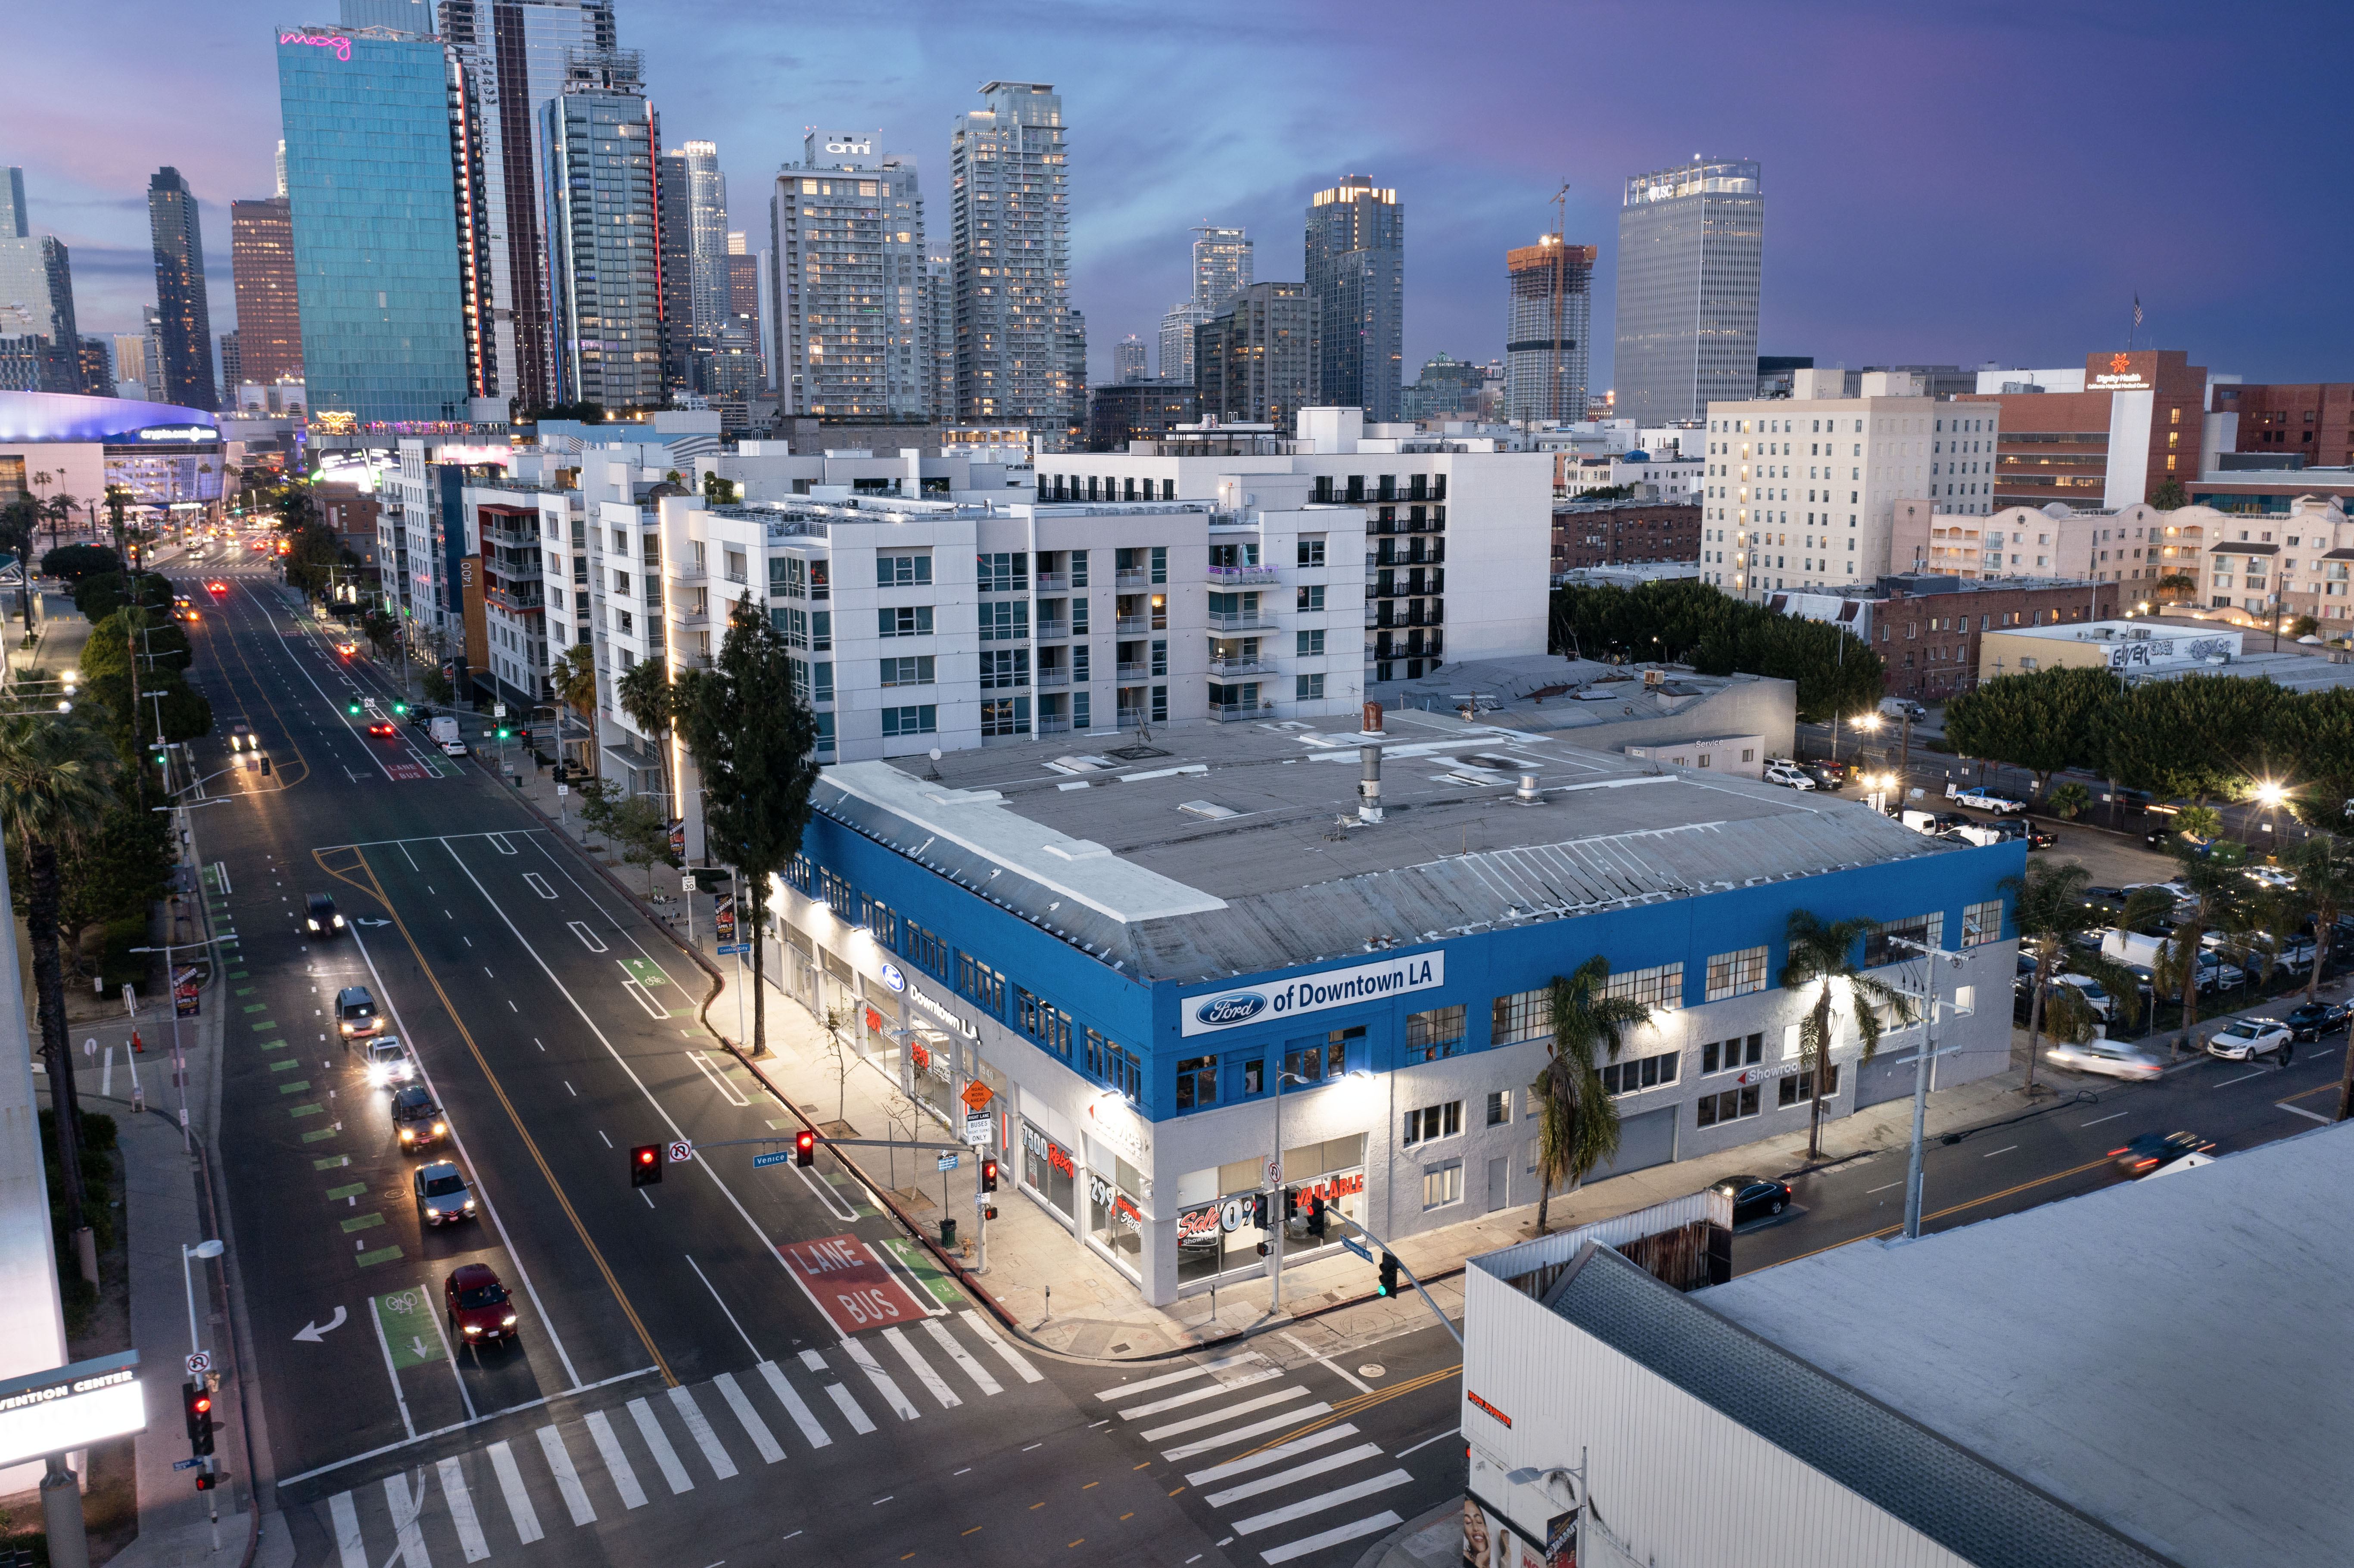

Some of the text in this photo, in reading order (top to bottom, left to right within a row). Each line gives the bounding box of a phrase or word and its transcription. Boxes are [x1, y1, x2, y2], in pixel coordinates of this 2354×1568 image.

[280, 34, 352, 61] moxy
[825, 141, 871, 155] onni
[1657, 184, 1672, 199] USC
[2096, 373, 2141, 384] Dignity Health
[461, 563, 473, 588] 1400
[1695, 739, 1723, 748] Service
[716, 898, 733, 914] SUMMIT
[1210, 961, 1432, 1021] Ford of Downtown LA
[866, 1007, 881, 1034] 389
[911, 984, 960, 1031] Downtown
[962, 1019, 981, 1045] LA
[979, 1064, 993, 1080] 1540
[1749, 1063, 1800, 1082] Showroo
[757, 1155, 785, 1164] Venice
[1296, 1174, 1363, 1208] VAILABLE
[1178, 1207, 1220, 1239] Sale
[791, 1240, 864, 1275] LANE
[1343, 1238, 1364, 1257] Figueroa
[837, 1289, 900, 1324] BUS
[74, 1370, 133, 1392] CENTER
[1469, 1391, 1483, 1406] SIGN
[1485, 1402, 1510, 1426] PAINTER
